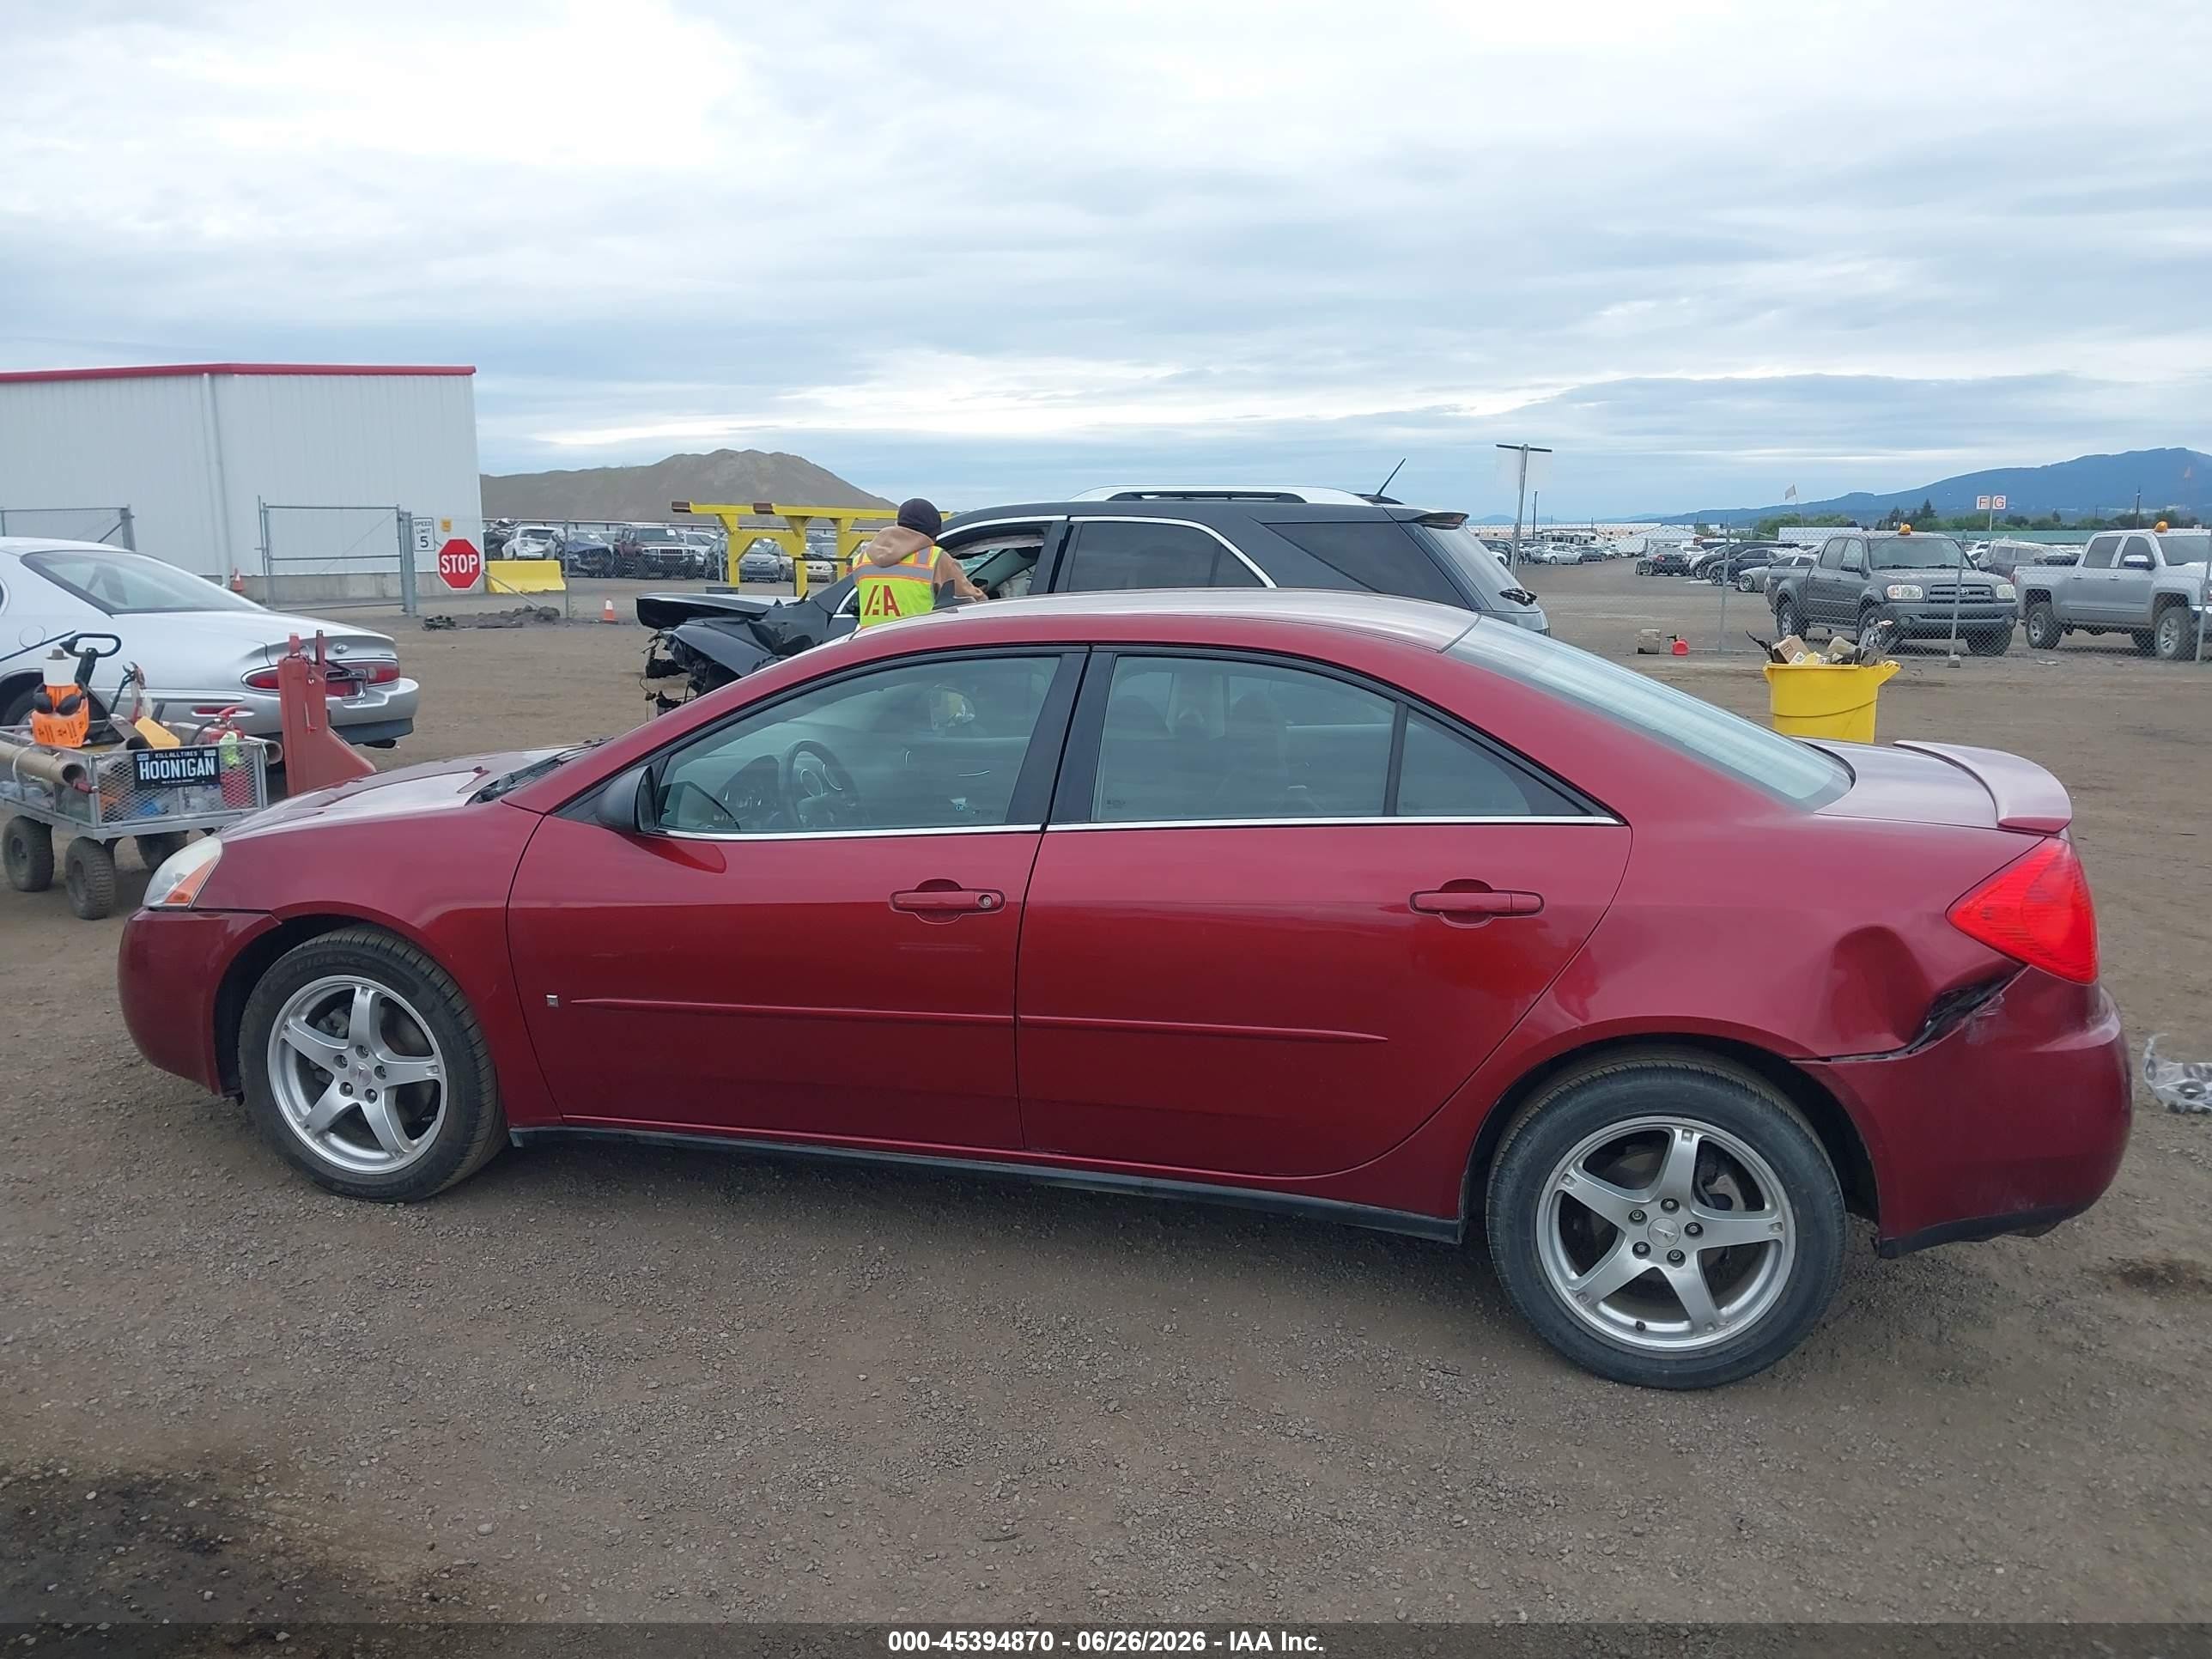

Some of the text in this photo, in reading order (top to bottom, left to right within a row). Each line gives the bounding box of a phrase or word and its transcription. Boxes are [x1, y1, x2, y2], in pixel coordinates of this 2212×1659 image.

[1978, 496, 1988, 508] F
[1994, 496, 2005, 508] G
[420, 535, 429, 548] 5
[441, 554, 478, 574] STOP
